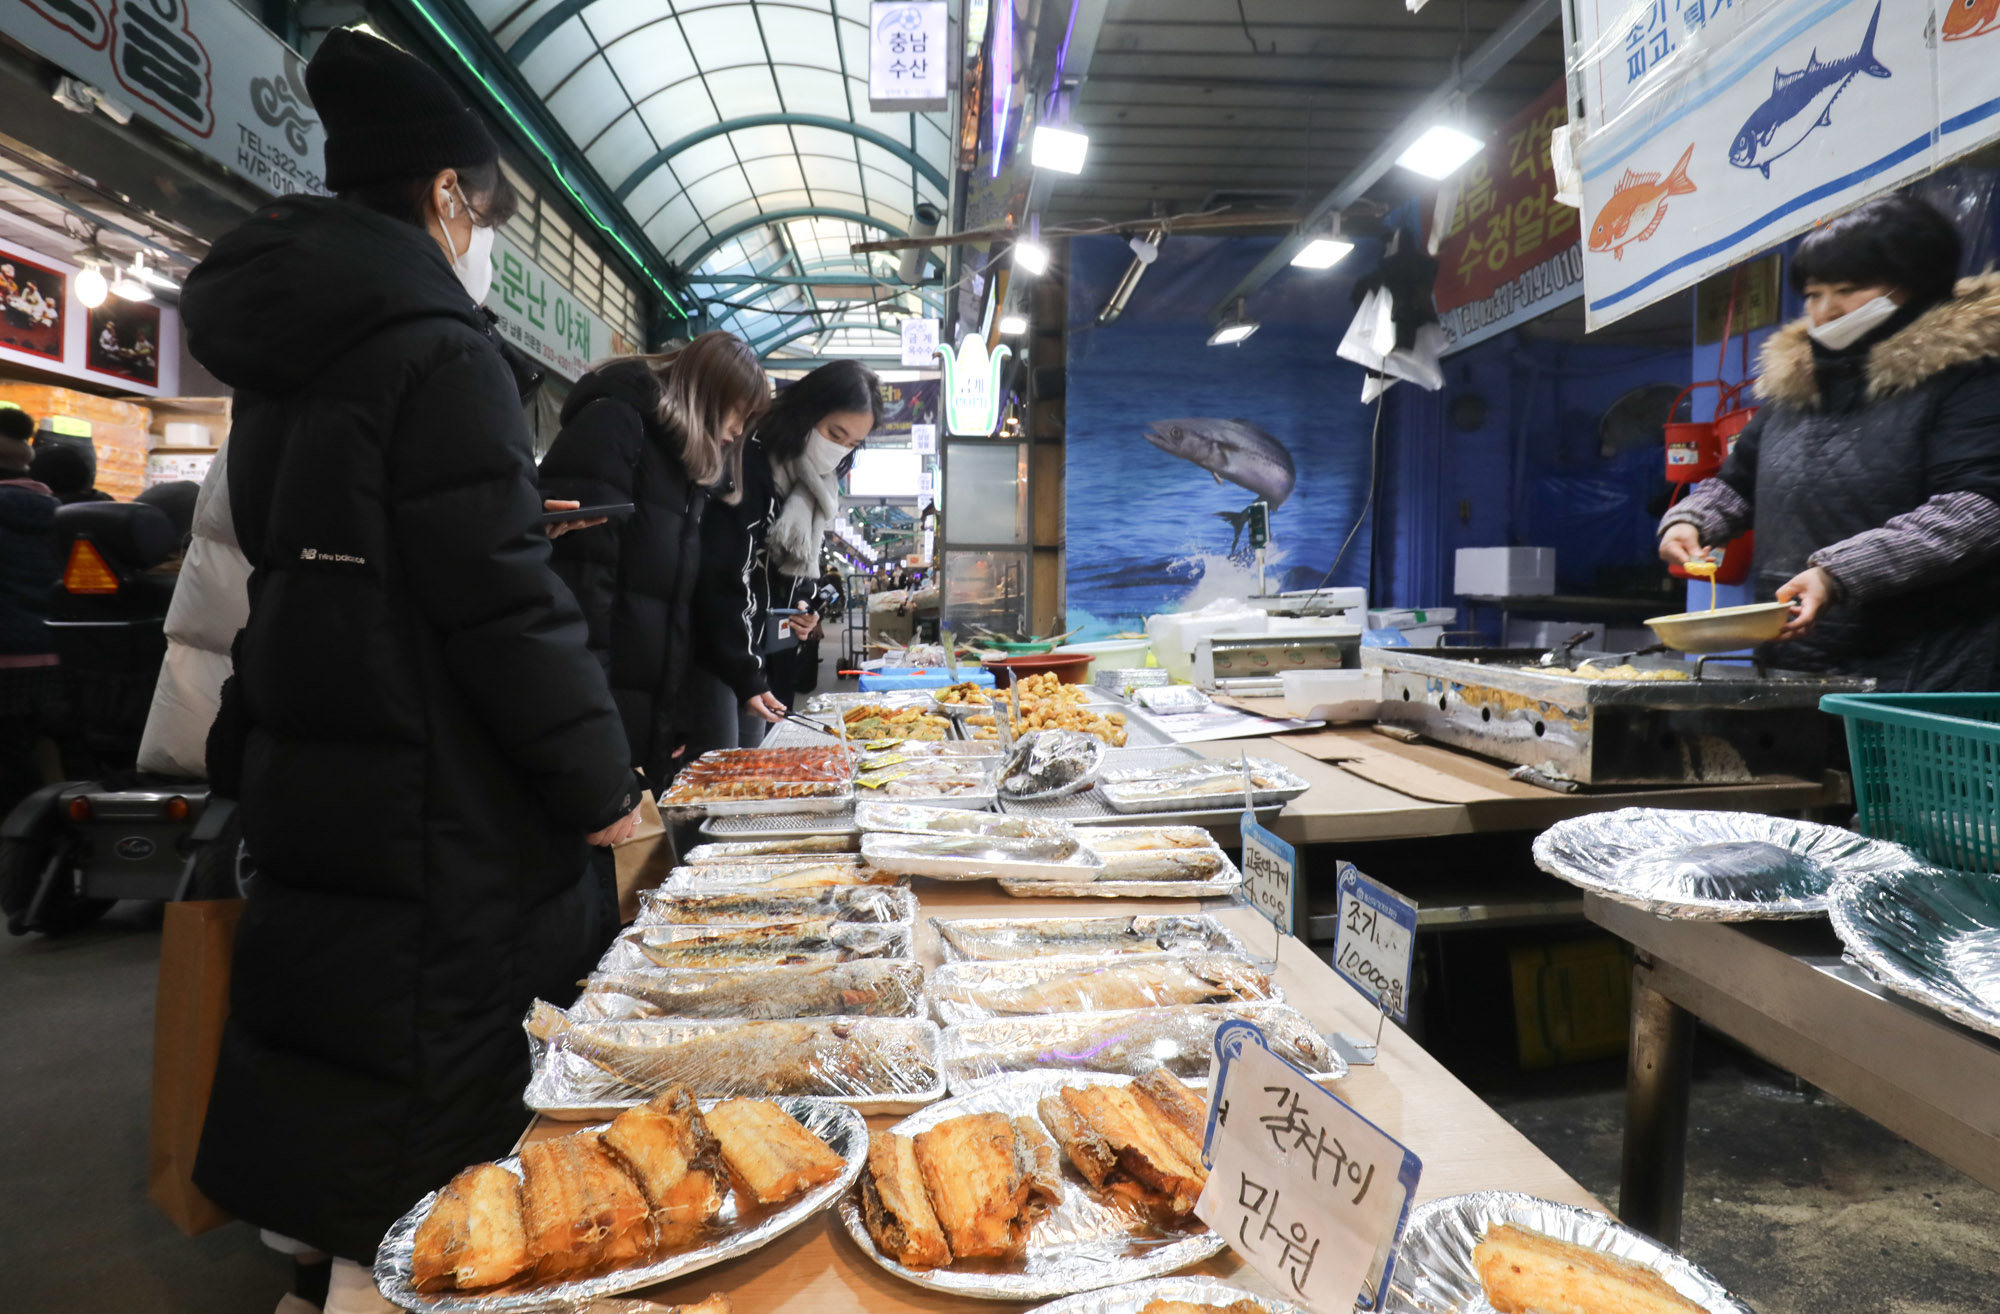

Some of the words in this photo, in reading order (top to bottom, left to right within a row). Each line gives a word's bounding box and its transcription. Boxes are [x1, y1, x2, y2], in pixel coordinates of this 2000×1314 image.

[889, 32, 928, 53] 충남
[1626, 27, 1676, 84] 찌고.
[889, 59, 928, 79] 수산
[1457, 183, 1577, 287] 수정얼음
[555, 296, 590, 363] 야채
[335, 554, 365, 565] balance
[1245, 847, 1290, 897] 고등어구이
[1347, 901, 1377, 943] 조기
[1239, 1171, 1321, 1300] 만원
